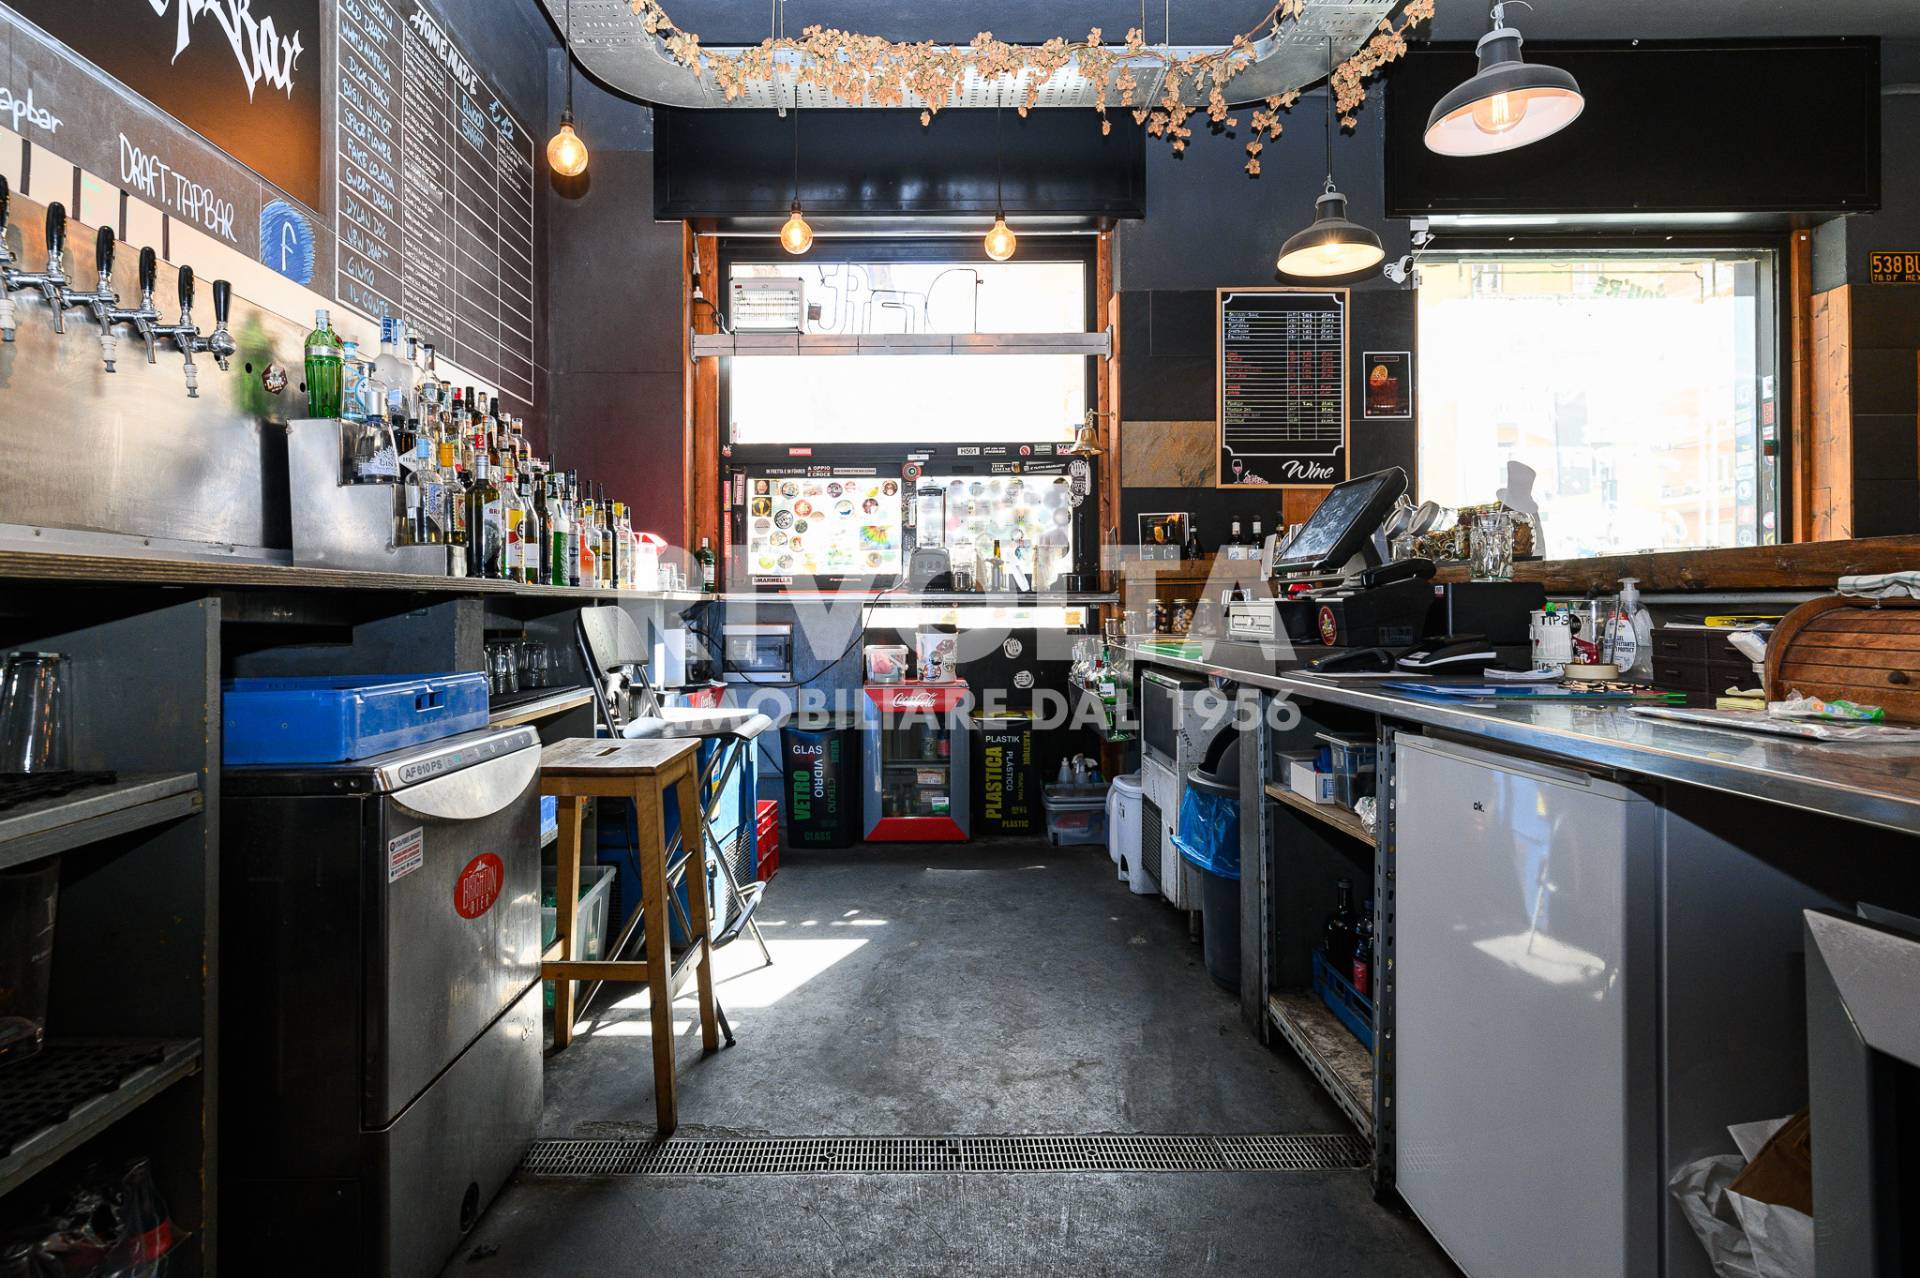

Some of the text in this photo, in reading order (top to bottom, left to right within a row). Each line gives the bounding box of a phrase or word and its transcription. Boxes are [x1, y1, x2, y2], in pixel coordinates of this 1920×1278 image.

[1872, 255, 1903, 273] 538
[1281, 460, 1335, 479] Wine
[1541, 615, 1570, 626] TIPS
[985, 735, 1020, 743] PLASTIK
[792, 744, 823, 755] GLAS
[814, 759, 824, 799] VIDRIO
[1006, 751, 1014, 792] PLASTICO
[985, 746, 1003, 819] PLASTICA
[793, 770, 811, 820] VETRO
